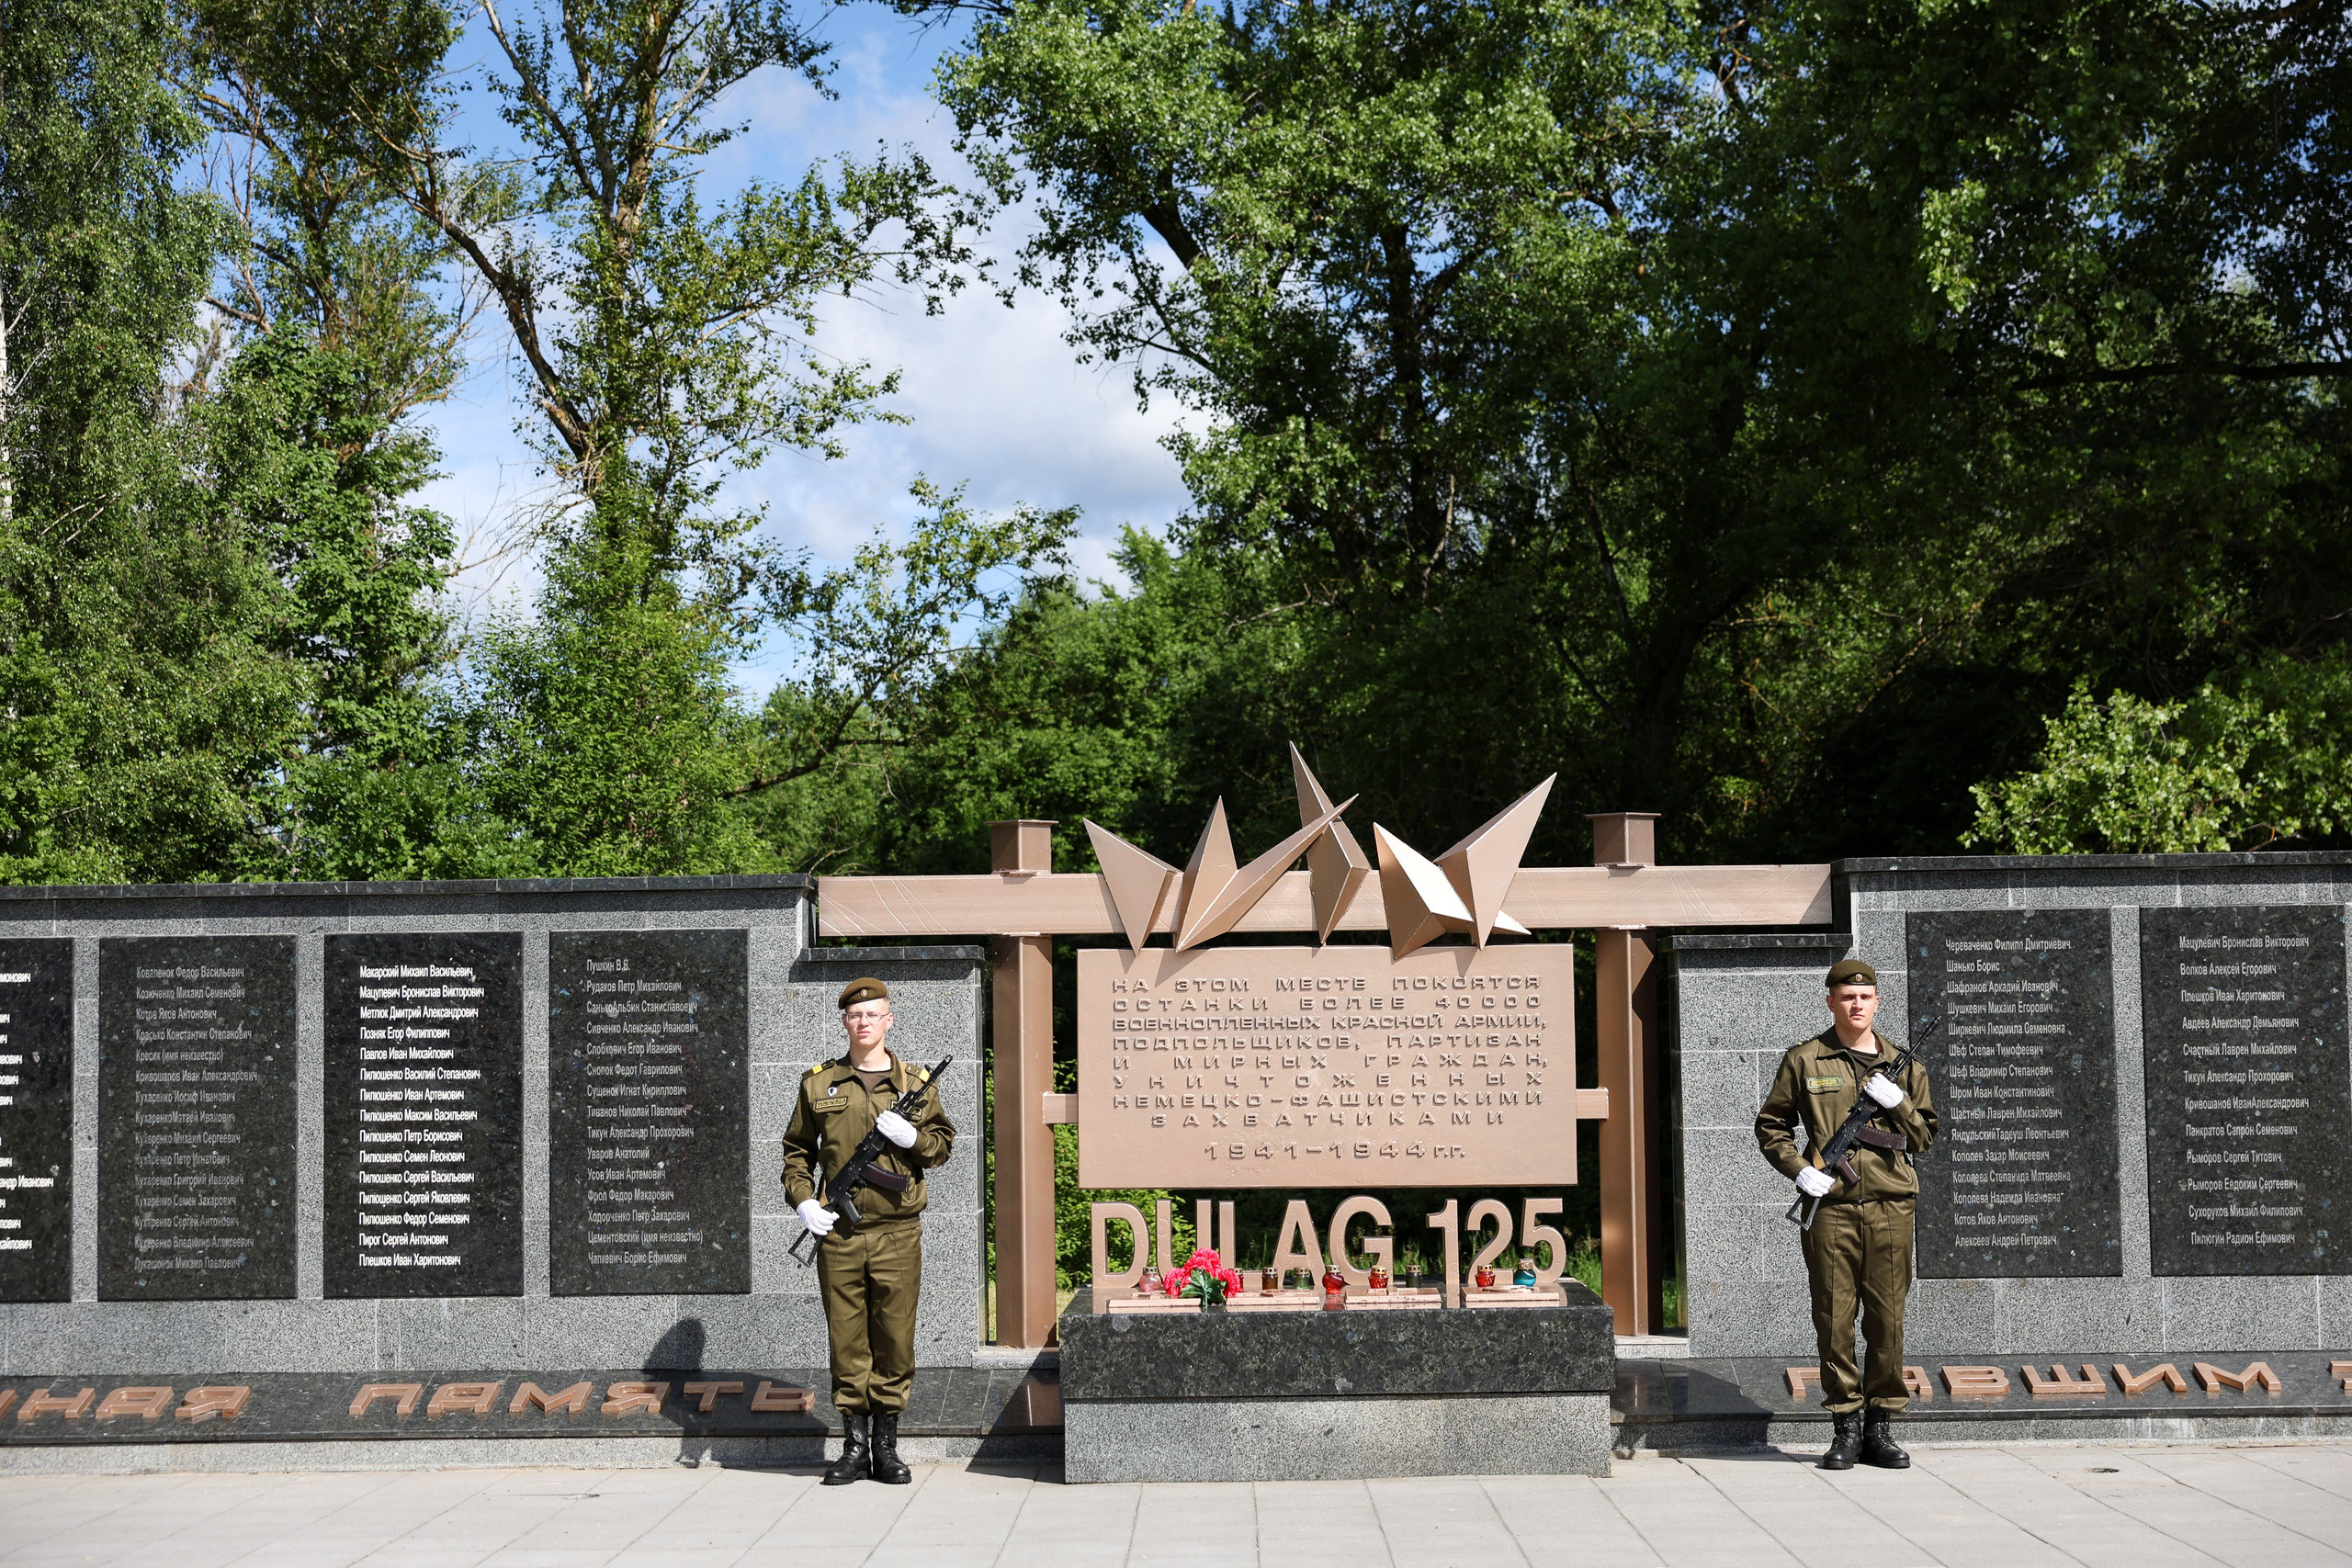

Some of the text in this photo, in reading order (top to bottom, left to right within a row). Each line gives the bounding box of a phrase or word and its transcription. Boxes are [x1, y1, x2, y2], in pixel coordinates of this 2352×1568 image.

[1995, 938, 2023, 952] Филипп
[2025, 937, 2071, 953] Дмитриевич
[2180, 935, 2309, 951] Мацулевич Бронислав Викторович
[176, 965, 199, 980] Федор
[201, 965, 243, 977] Васильевич
[360, 964, 472, 980] Макарский Михаил Васильевич
[587, 959, 630, 974] Пушкин В.В.
[1947, 960, 2000, 975] Шанько Борис
[2180, 962, 2277, 976] Волков Алексей Егорович
[587, 979, 682, 994] Рудаков Петр Михайлович
[1113, 976, 1540, 992] НА ЭТОМ МЕСТЕ ПОКОЯТСЯ
[1947, 980, 2058, 996] Шафранов Аркадий Иванович
[360, 985, 484, 1000] Мацулевич Бронислав Викторович
[2181, 988, 2284, 1003] Плешков Иван Харитонович
[1113, 995, 1542, 1012] ОСТАНКИ БОЛЕЕ 40000
[1948, 1001, 2052, 1017] Шушкевич Михаил Егорович
[137, 1007, 217, 1019] Котов Яков Антонович
[361, 1005, 479, 1021] Метлюк Дмитрий Александрович
[587, 1021, 698, 1035] Сивченко Александр Иванович
[1113, 1014, 1547, 1032] ВОЕННОПЛЕННЫХ КРАСНОЙ АРМИИ,
[2182, 1015, 2299, 1031] Авдеев Александр Демьянович
[361, 1026, 450, 1041] Позняк Егор Филиппович
[628, 1042, 644, 1056] Егор
[647, 1042, 682, 1053] Иванович
[1113, 1034, 1543, 1051] ПОДПОЛЬЩИКОВ, ПАРТИЗАН
[2184, 1042, 2297, 1057] Счастный Лаврен Михайлович
[361, 1046, 454, 1059] Павлов Иван Михайлович
[1113, 1053, 1549, 1069] И МИРНЫХ ГРАЖДАН,
[361, 1067, 480, 1079] Пилюшенко Василий Степанович
[616, 1063, 637, 1077] Федот
[639, 1063, 682, 1077] Гаврилович
[2184, 1069, 2293, 1085] Тикун Александр Прохорович
[1113, 1072, 1544, 1089] УНИЧТОЖЕННЫХ
[361, 1088, 464, 1102] Пилюшенко Иван Артемович
[1113, 1092, 1544, 1109] НЕМЕЦКО-ФАШИСТСКИМИ
[360, 1108, 477, 1121] Пилюшенко Максим Васильевич
[619, 1105, 649, 1116] Николай
[651, 1104, 686, 1116] Павлович
[1150, 1111, 1505, 1127] ЗАХВАТЧИКАМИ
[360, 1129, 462, 1144] Пилюшенко Петр Борисович
[587, 1125, 694, 1140] Тикун Александр Прохорович
[2186, 1123, 2224, 1138] Панкратов
[2256, 1122, 2297, 1134] Семенович
[360, 1149, 465, 1162] Пилюшенко Семен Леонович
[587, 1147, 650, 1161] Уваров Анатолий
[2187, 1150, 2281, 1166] Рыморов Сергей Титович
[17, 1175, 54, 1188] Иванович
[359, 1170, 474, 1185] Пилюшенко Сергей Васильевич
[2188, 1177, 2297, 1192] Рыморов Евдоким Сергеевич
[359, 1190, 469, 1206] Пилюшенко Сергей Яковлевич
[359, 1212, 469, 1226] Пилюшенко Федор Семенович
[1955, 1213, 2038, 1224] Котов Яков Антонович
[2189, 1205, 2228, 1220] Сухоруков
[2230, 1204, 2258, 1216] Михаил
[359, 1233, 448, 1247] Пирог Сергей Антонович
[1091, 1194, 1567, 1289] DULAG 125
[2191, 1231, 2295, 1246] Пилюгин Радион Ефимович
[359, 1253, 460, 1269] Плешков Иван Харитонович
[348, 1380, 817, 1416] ПАМЯТЬ
